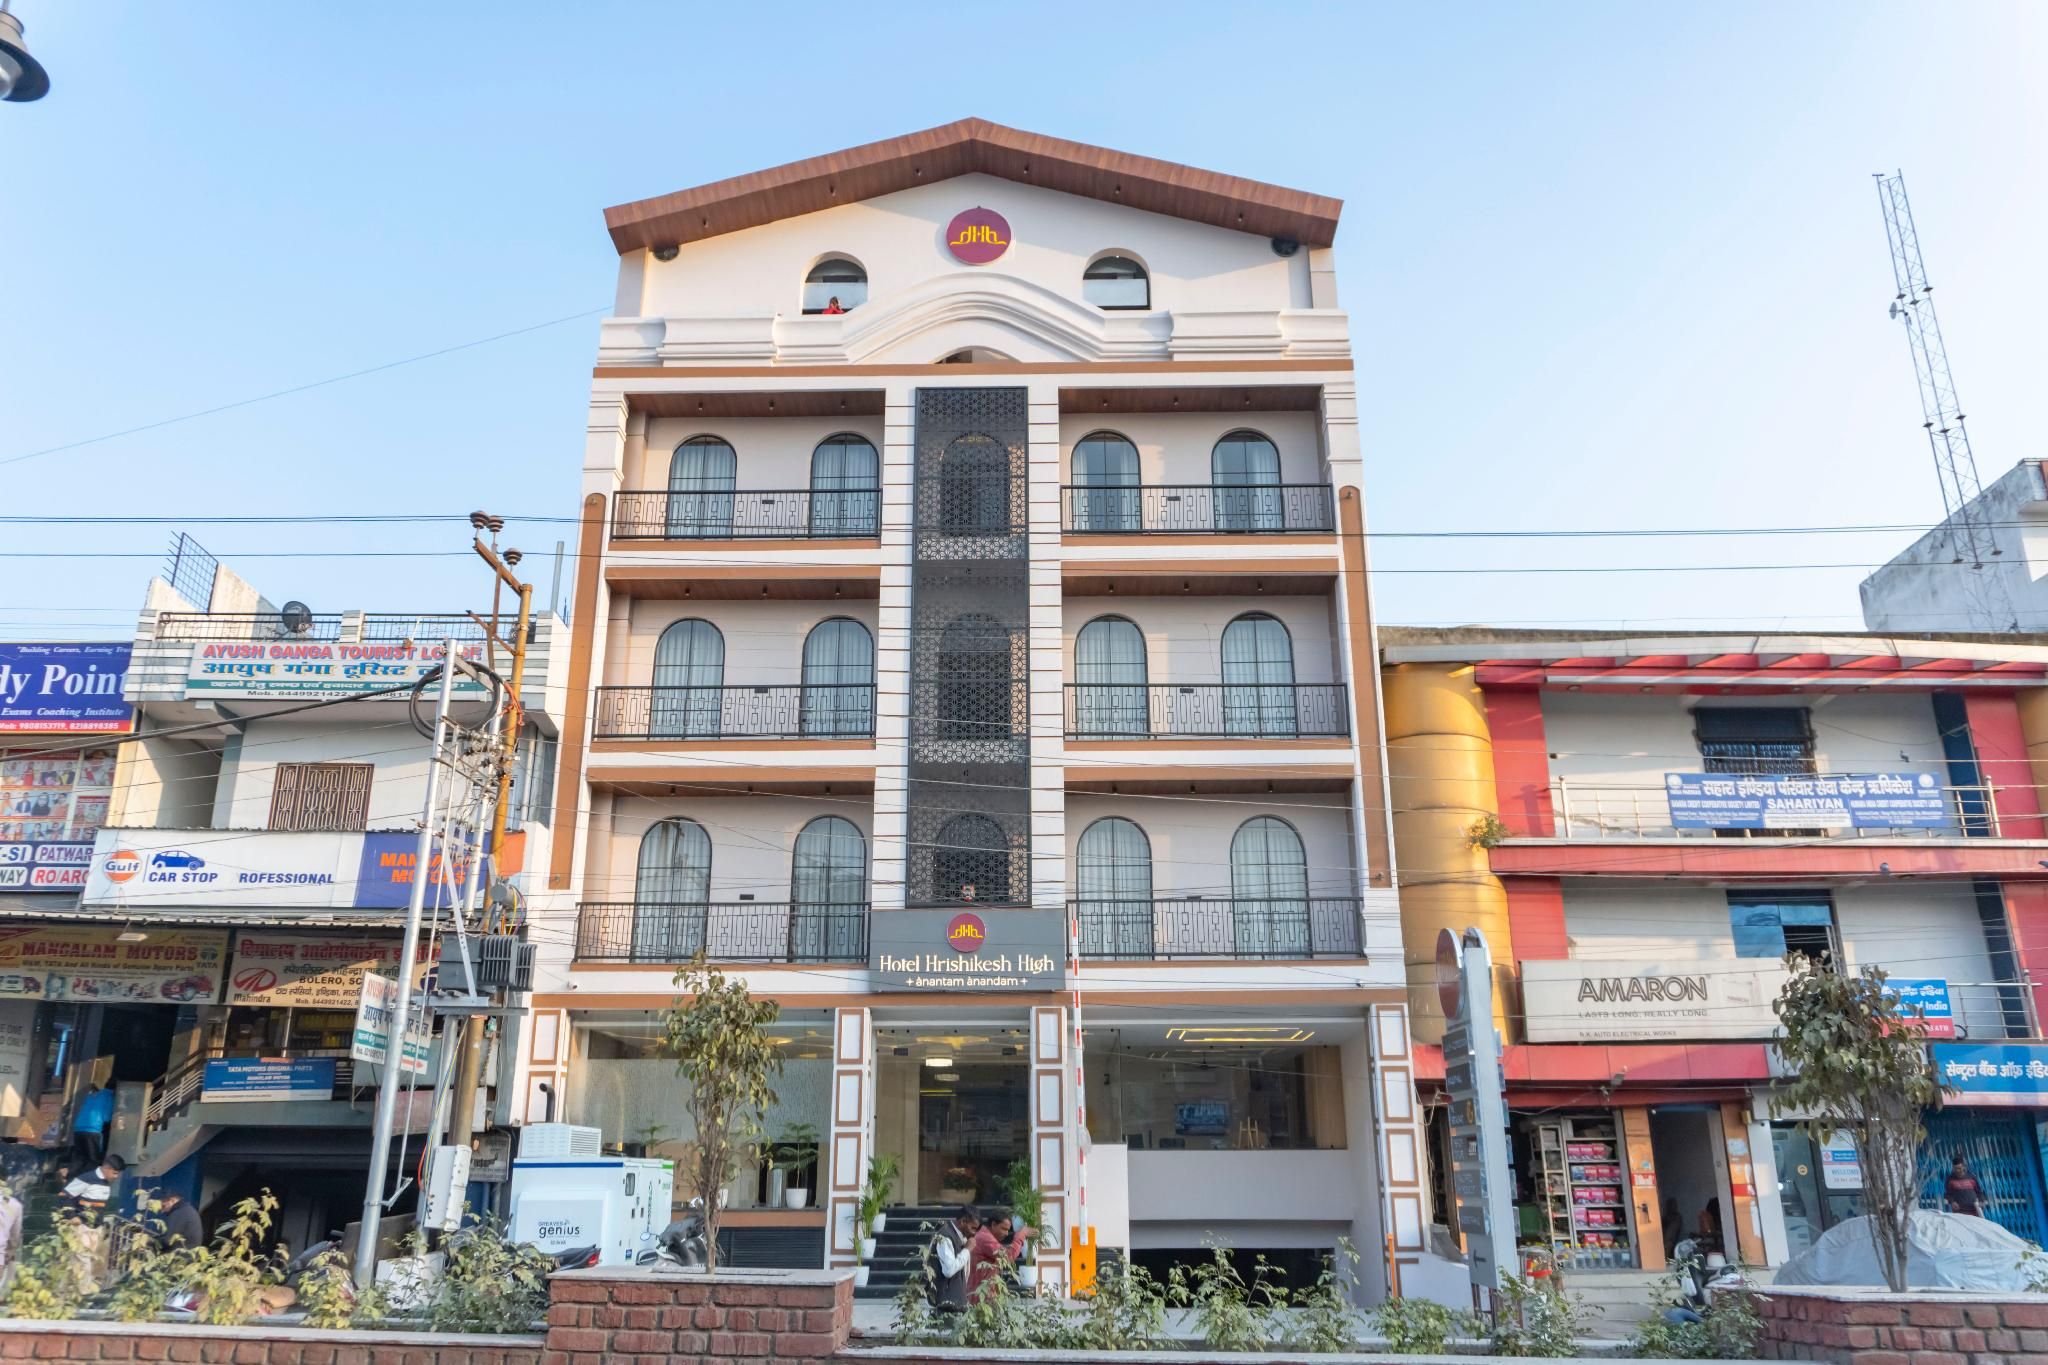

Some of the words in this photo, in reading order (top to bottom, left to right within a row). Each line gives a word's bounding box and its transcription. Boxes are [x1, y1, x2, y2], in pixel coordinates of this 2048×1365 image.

[202, 644, 265, 659] AYUSH
[269, 645, 333, 660] GANGA
[339, 645, 416, 660] TOURIST
[202, 662, 275, 678] आयुष
[283, 661, 335, 676] गंगा
[37, 708, 81, 718] Coaching
[85, 708, 124, 716] Institute
[1767, 798, 1844, 810] SAHARIYAN
[105, 861, 140, 872] Gulf
[148, 872, 177, 883] CAR
[182, 872, 218, 883] STOP
[22, 942, 117, 958] MANGALAM
[126, 944, 198, 961] MOTORS
[879, 954, 920, 973] Hotel
[926, 954, 1012, 972] Hrishikesh
[1018, 954, 1055, 975] High
[299, 976, 346, 986] BOLERO,
[1578, 977, 1708, 1001] AMARON
[1925, 1001, 1948, 1011] India
[538, 1225, 581, 1240] genius
